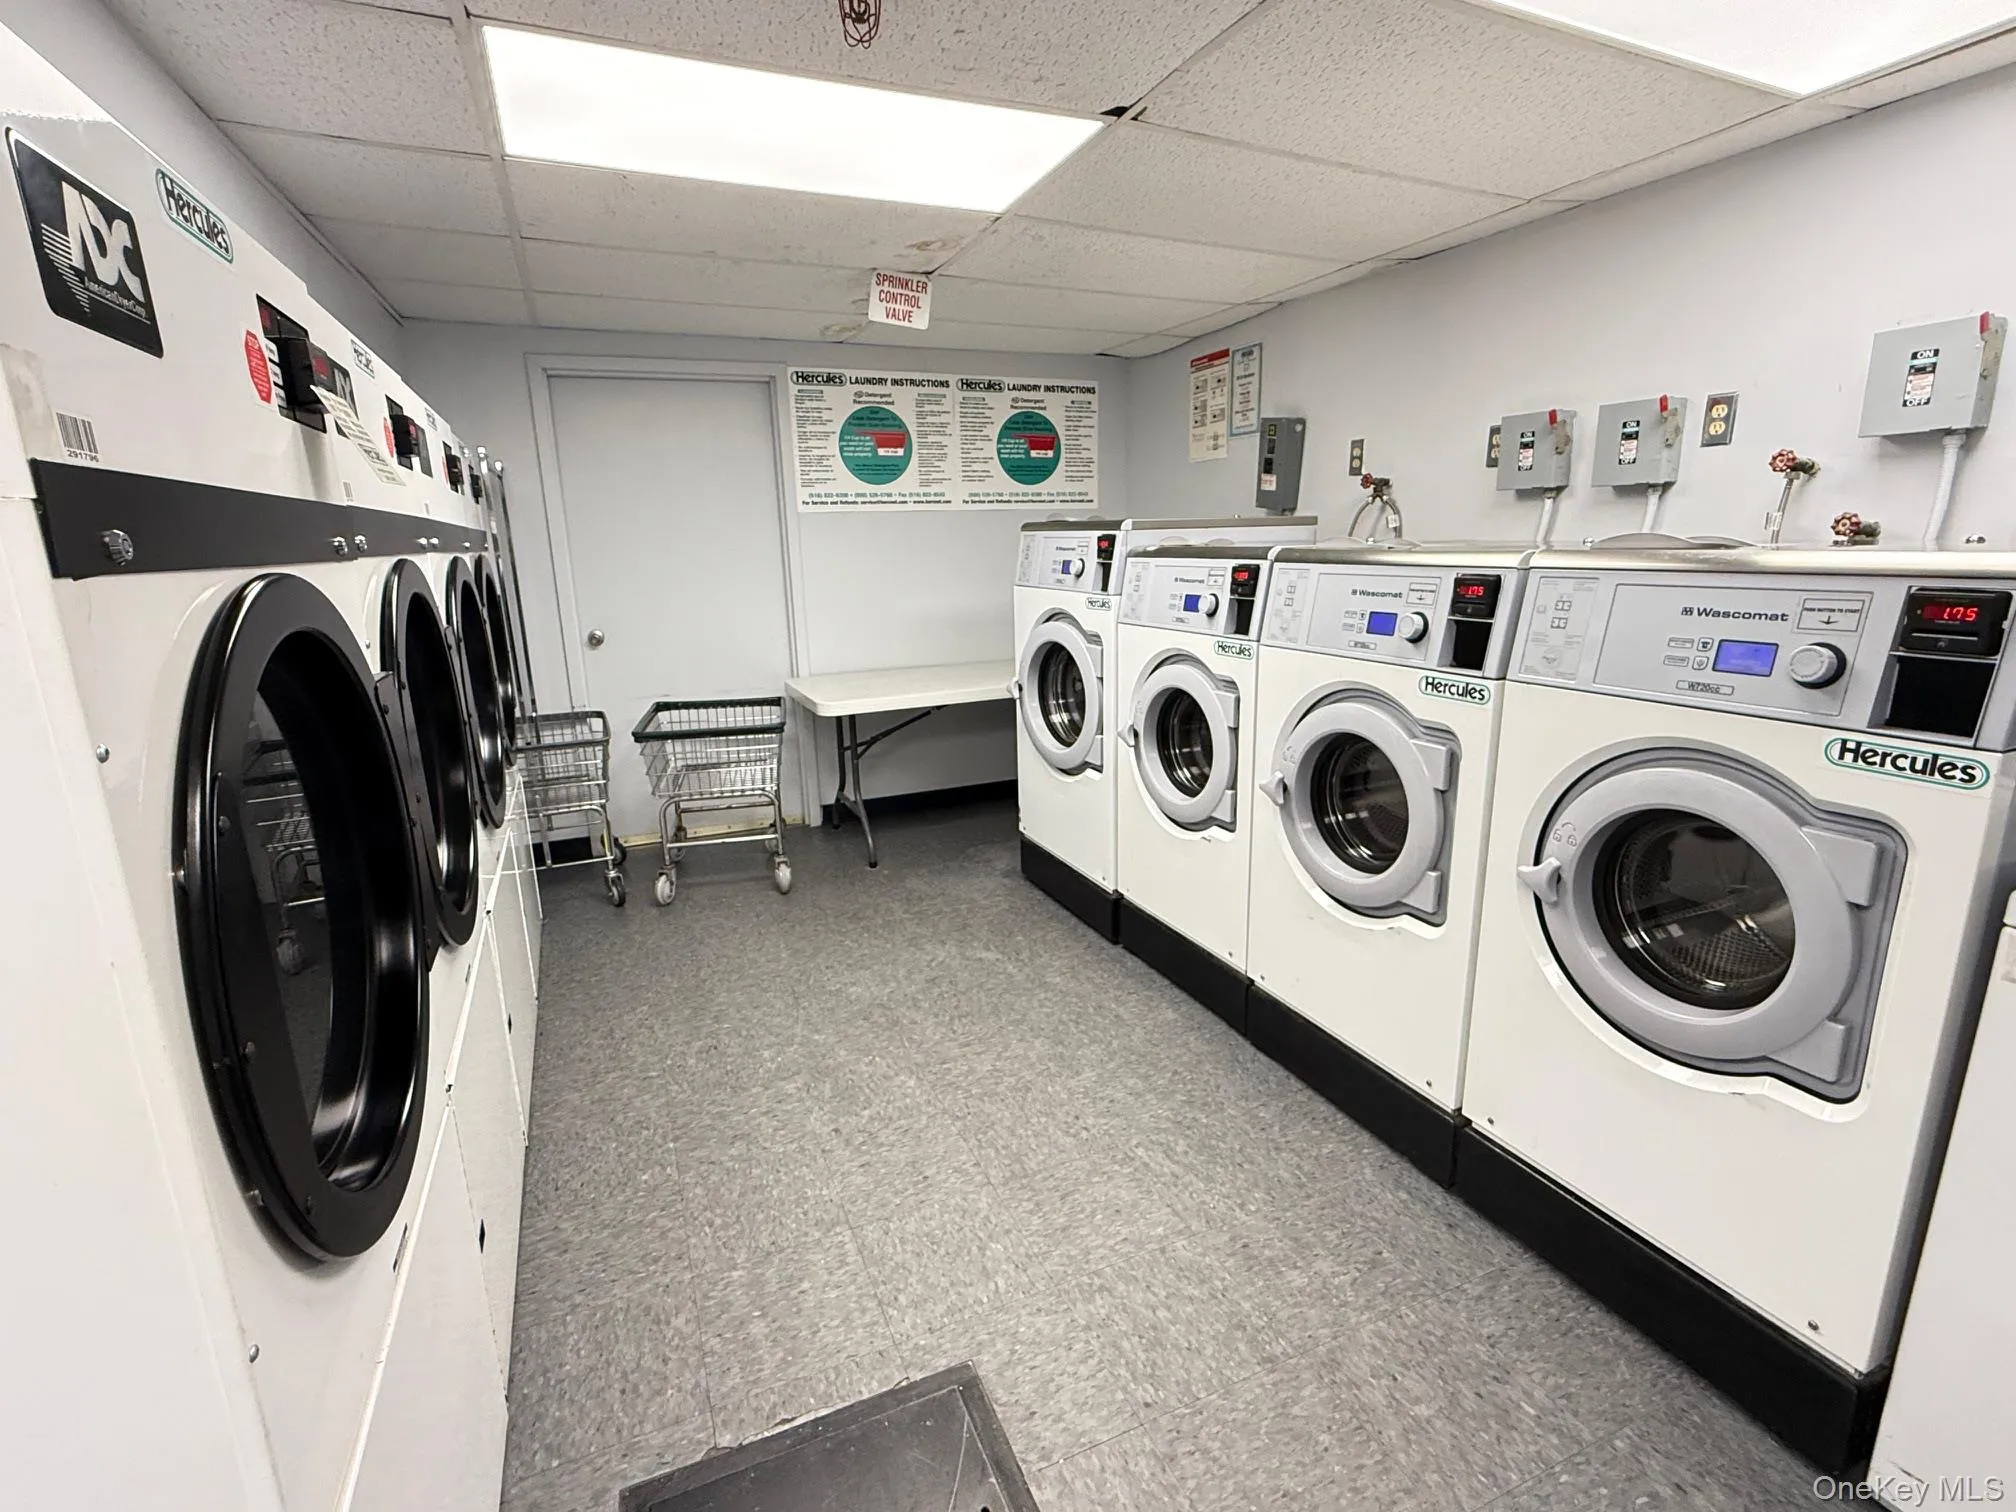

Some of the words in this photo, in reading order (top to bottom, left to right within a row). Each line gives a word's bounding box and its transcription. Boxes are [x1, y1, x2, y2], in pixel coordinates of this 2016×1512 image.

[162, 174, 230, 254] Hercules
[875, 272, 928, 295] SPRINKLER
[878, 289, 922, 309] CONTROL
[885, 305, 914, 323] VALVE
[1917, 350, 1934, 359] ON
[795, 371, 844, 385] Hercules
[849, 375, 889, 386] LAUNDRY
[890, 377, 950, 388] INSTRUCTIONS
[960, 378, 1003, 391] Hercules
[1007, 383, 1042, 392] LAUNDRY
[1043, 384, 1096, 395] INSTRUCTIONS
[1906, 397, 1929, 407] OFF
[66, 449, 100, 463] 291796
[1358, 589, 1403, 599] Wascomat
[1087, 598, 1112, 609] Hercules
[1696, 607, 1790, 622] Wascomat
[1216, 641, 1253, 658] Hercules
[1424, 676, 1487, 702] Hercules
[1837, 738, 1978, 785] Hercules
